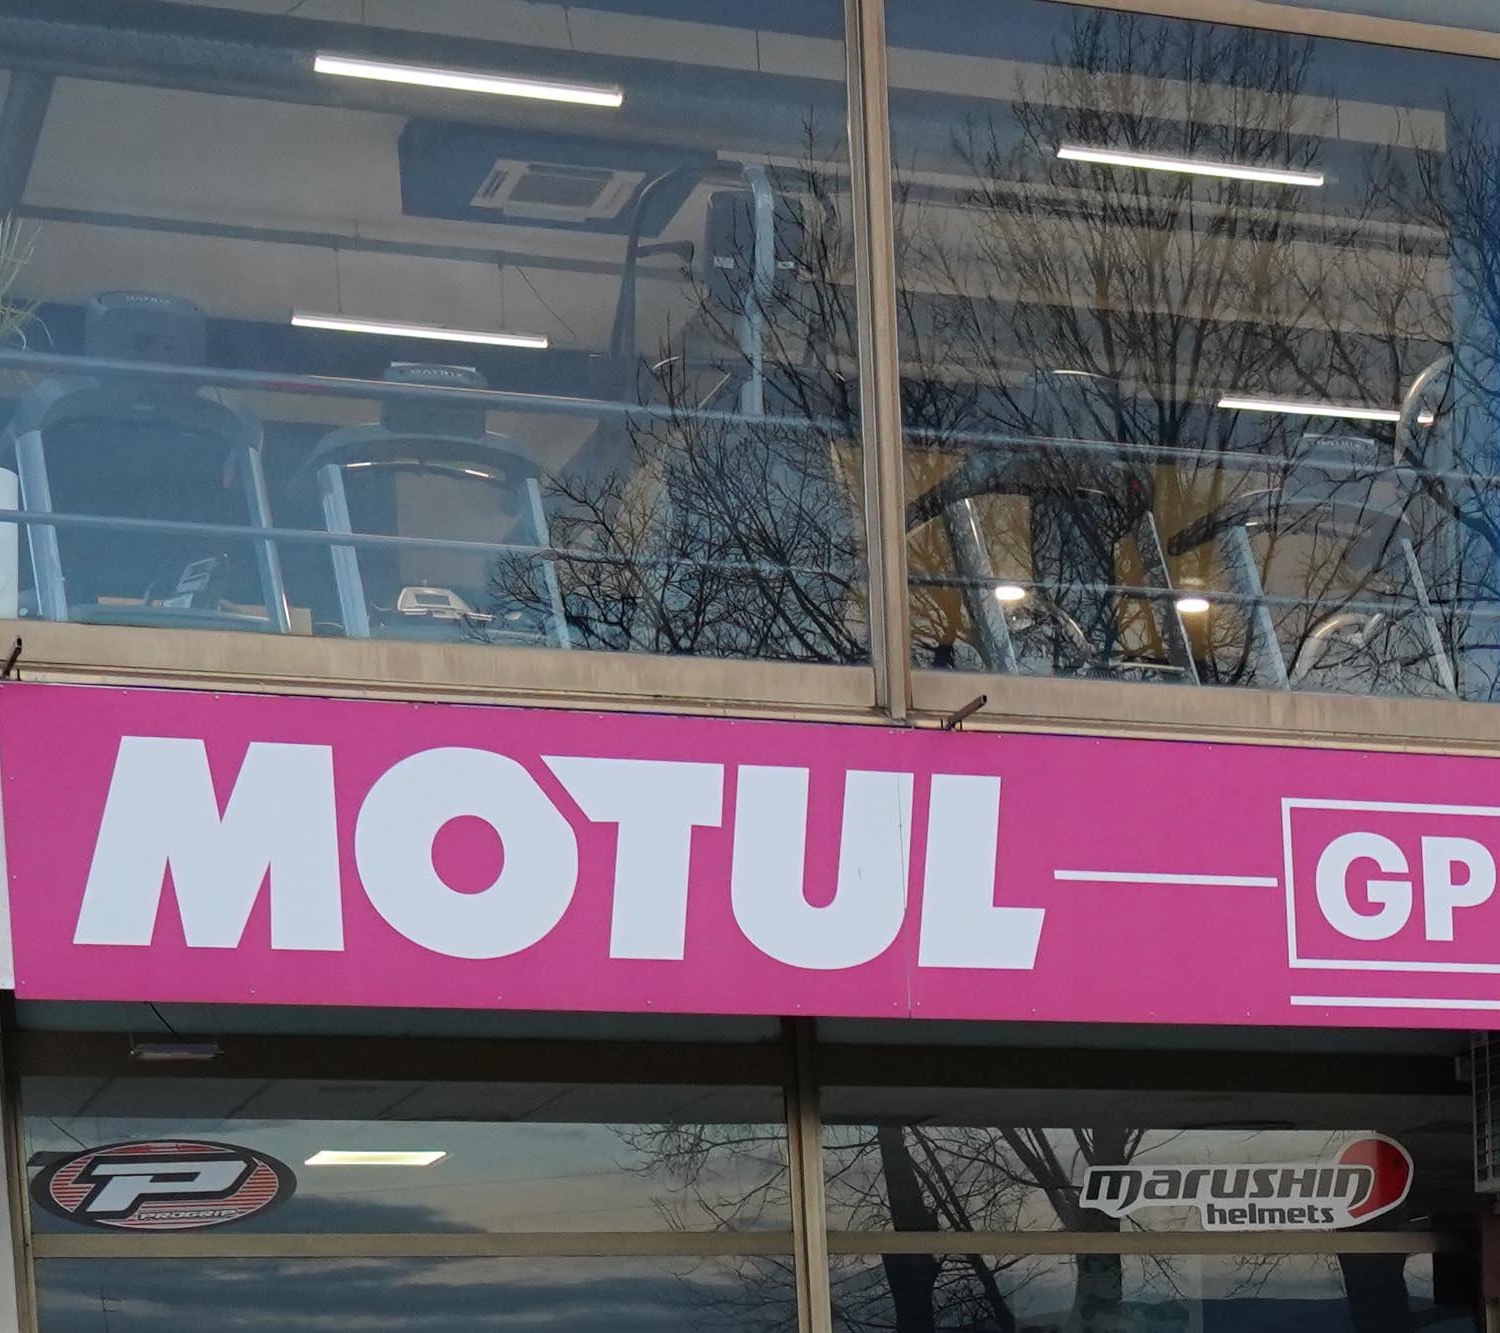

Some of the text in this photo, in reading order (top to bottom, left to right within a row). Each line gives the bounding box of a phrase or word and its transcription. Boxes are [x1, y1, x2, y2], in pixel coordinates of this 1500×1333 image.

[73, 734, 1046, 970] MOTUL
[1315, 831, 1496, 942] GP
[138, 1208, 239, 1221] PROGRIP
[1206, 1202, 1335, 1226] helmets
